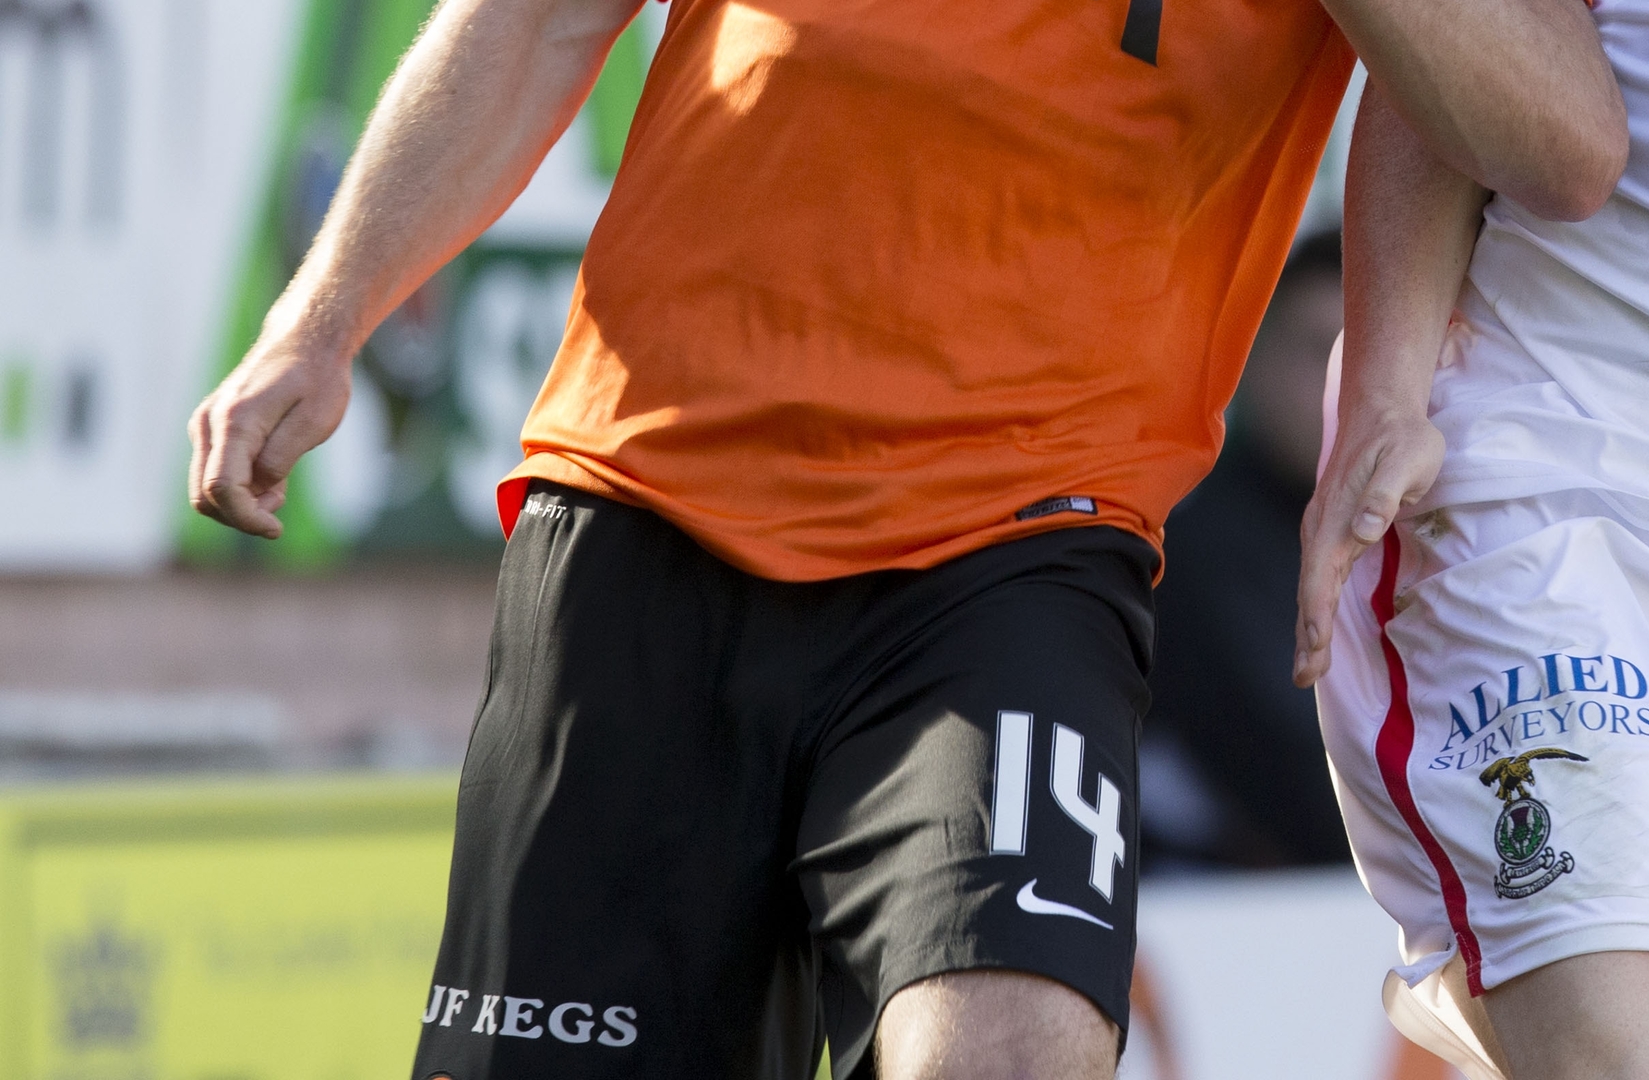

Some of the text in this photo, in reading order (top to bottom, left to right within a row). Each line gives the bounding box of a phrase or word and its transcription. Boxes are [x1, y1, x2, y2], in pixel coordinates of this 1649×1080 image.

[1440, 653, 1648, 752] ALLIED
[988, 710, 1126, 904] 14
[471, 994, 638, 1047] KEGS
